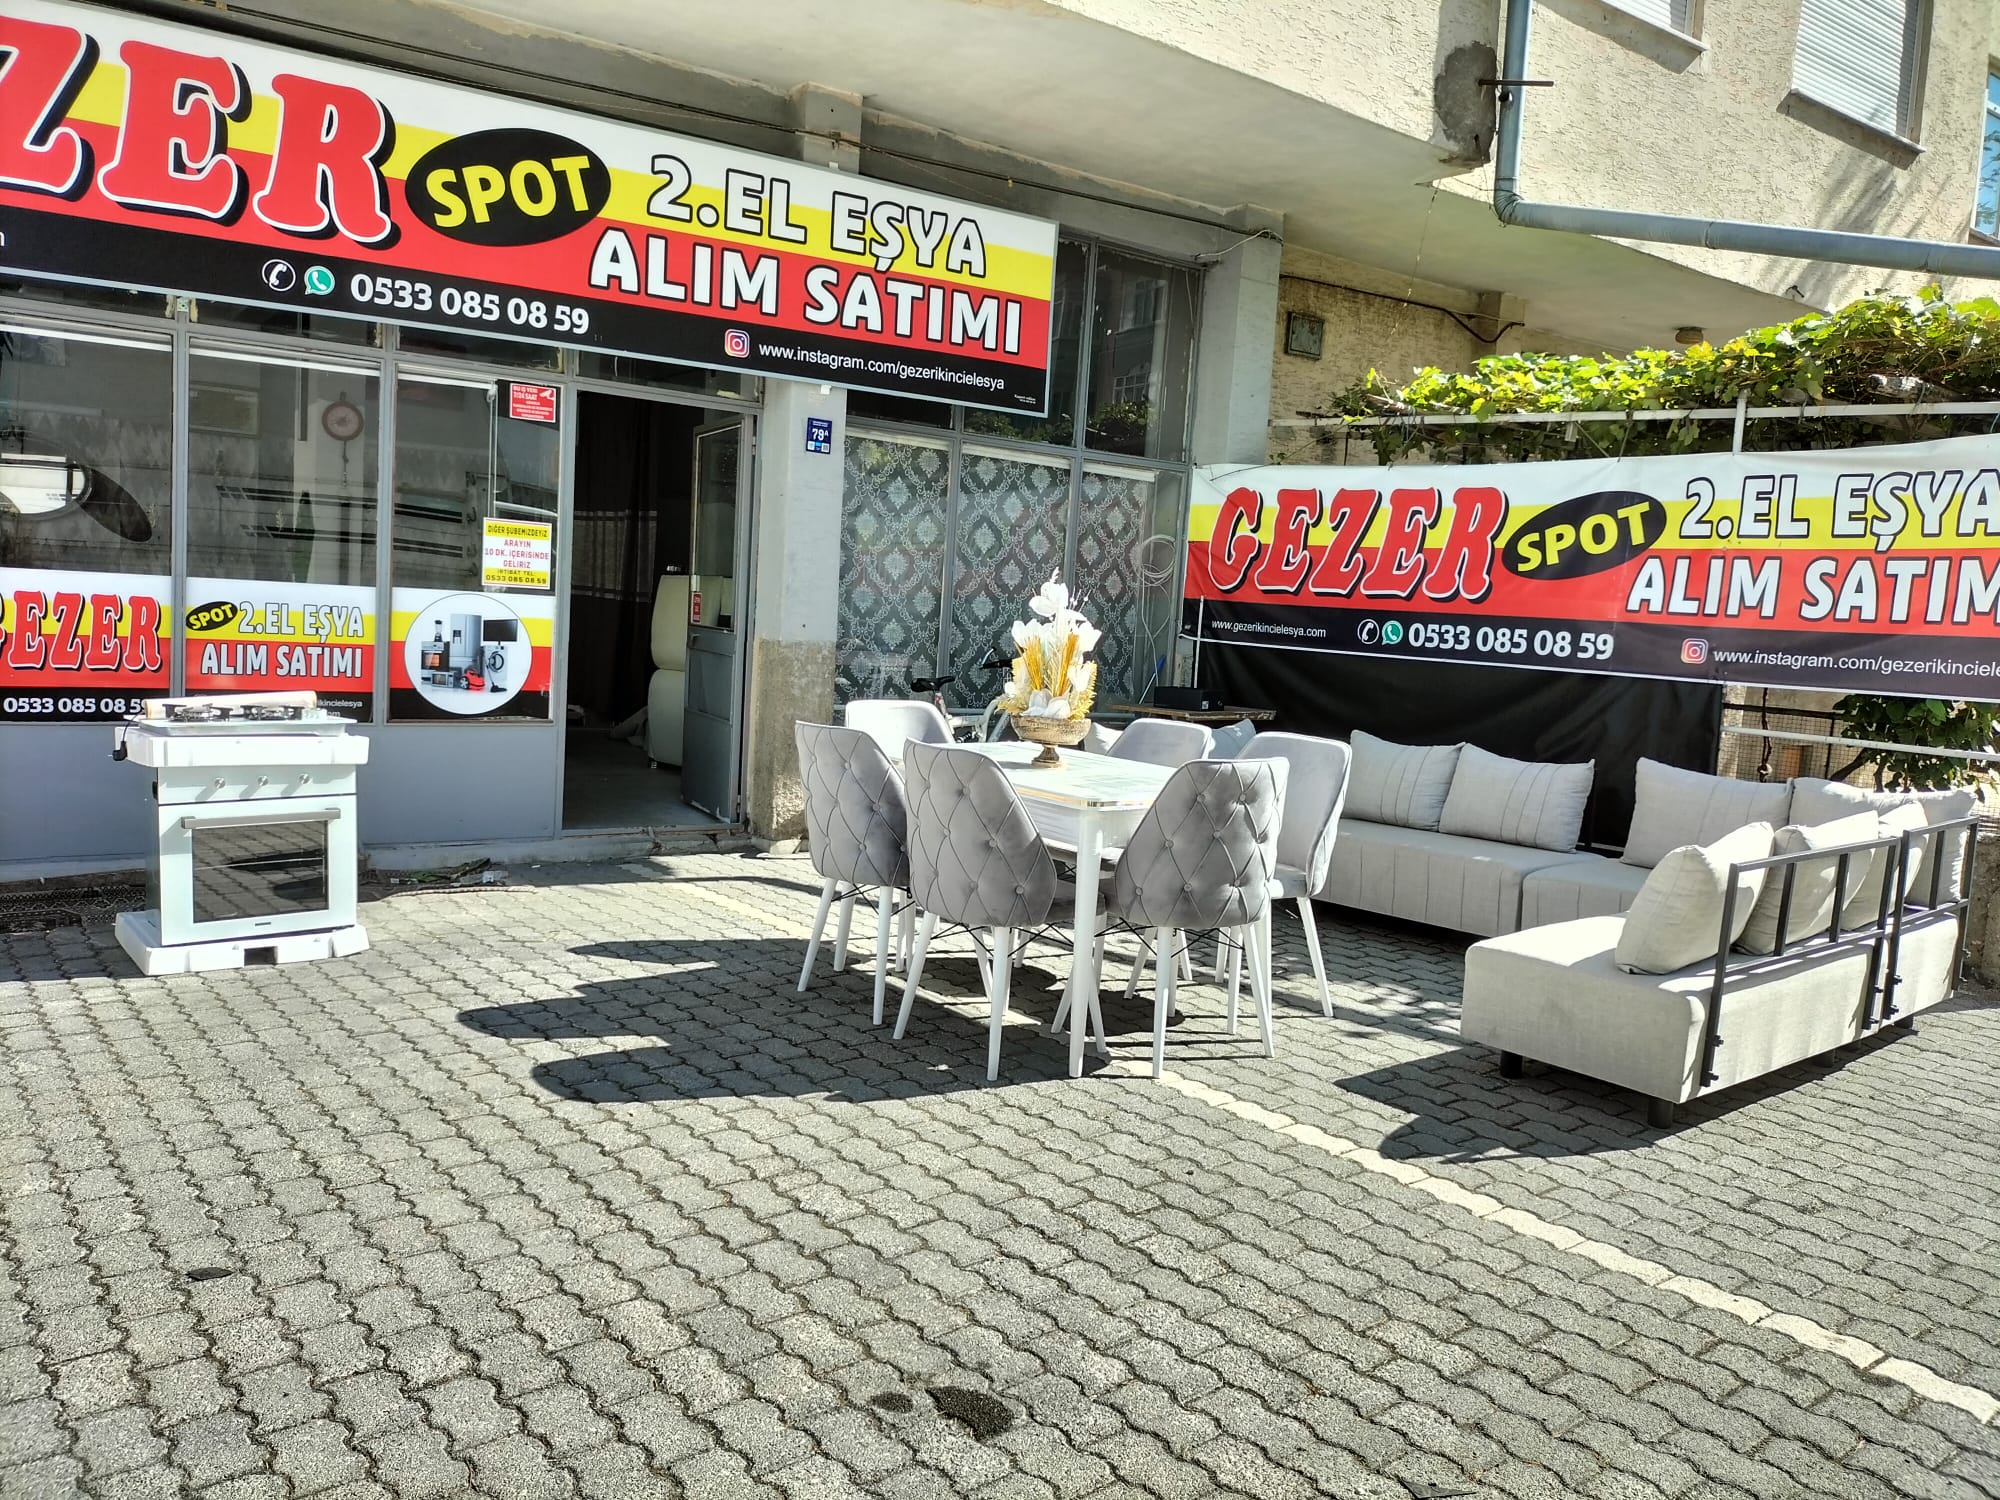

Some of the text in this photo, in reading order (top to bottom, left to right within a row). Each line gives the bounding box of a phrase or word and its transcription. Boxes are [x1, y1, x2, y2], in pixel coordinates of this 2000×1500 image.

[426, 155, 592, 229] SPOT
[646, 153, 987, 278] 2.EL EŞYA
[351, 273, 590, 335] 0533 085 08 59
[588, 227, 1022, 355] ALIM SATIMI
[759, 342, 1005, 392] www.instagram.com/gezerikincielesya
[1517, 501, 1651, 572] SPOT
[1678, 469, 2000, 553] 2.EL EŞYA
[504, 540, 531, 548] ARAYIN
[1208, 486, 1510, 603] GEZER
[188, 603, 235, 630] SPOT
[1626, 555, 1782, 618] ALIM
[0, 590, 165, 674] EZER
[238, 601, 366, 644] 2.EL EŞYA
[1211, 619, 1327, 638] www.gezerikincielesya.com
[1408, 622, 1615, 660] 0533 085 08 59
[200, 642, 364, 679] ALIM SATIMI
[3, 697, 55, 713] 0533
[58, 697, 97, 713] 085
[100, 699, 127, 713] 08
